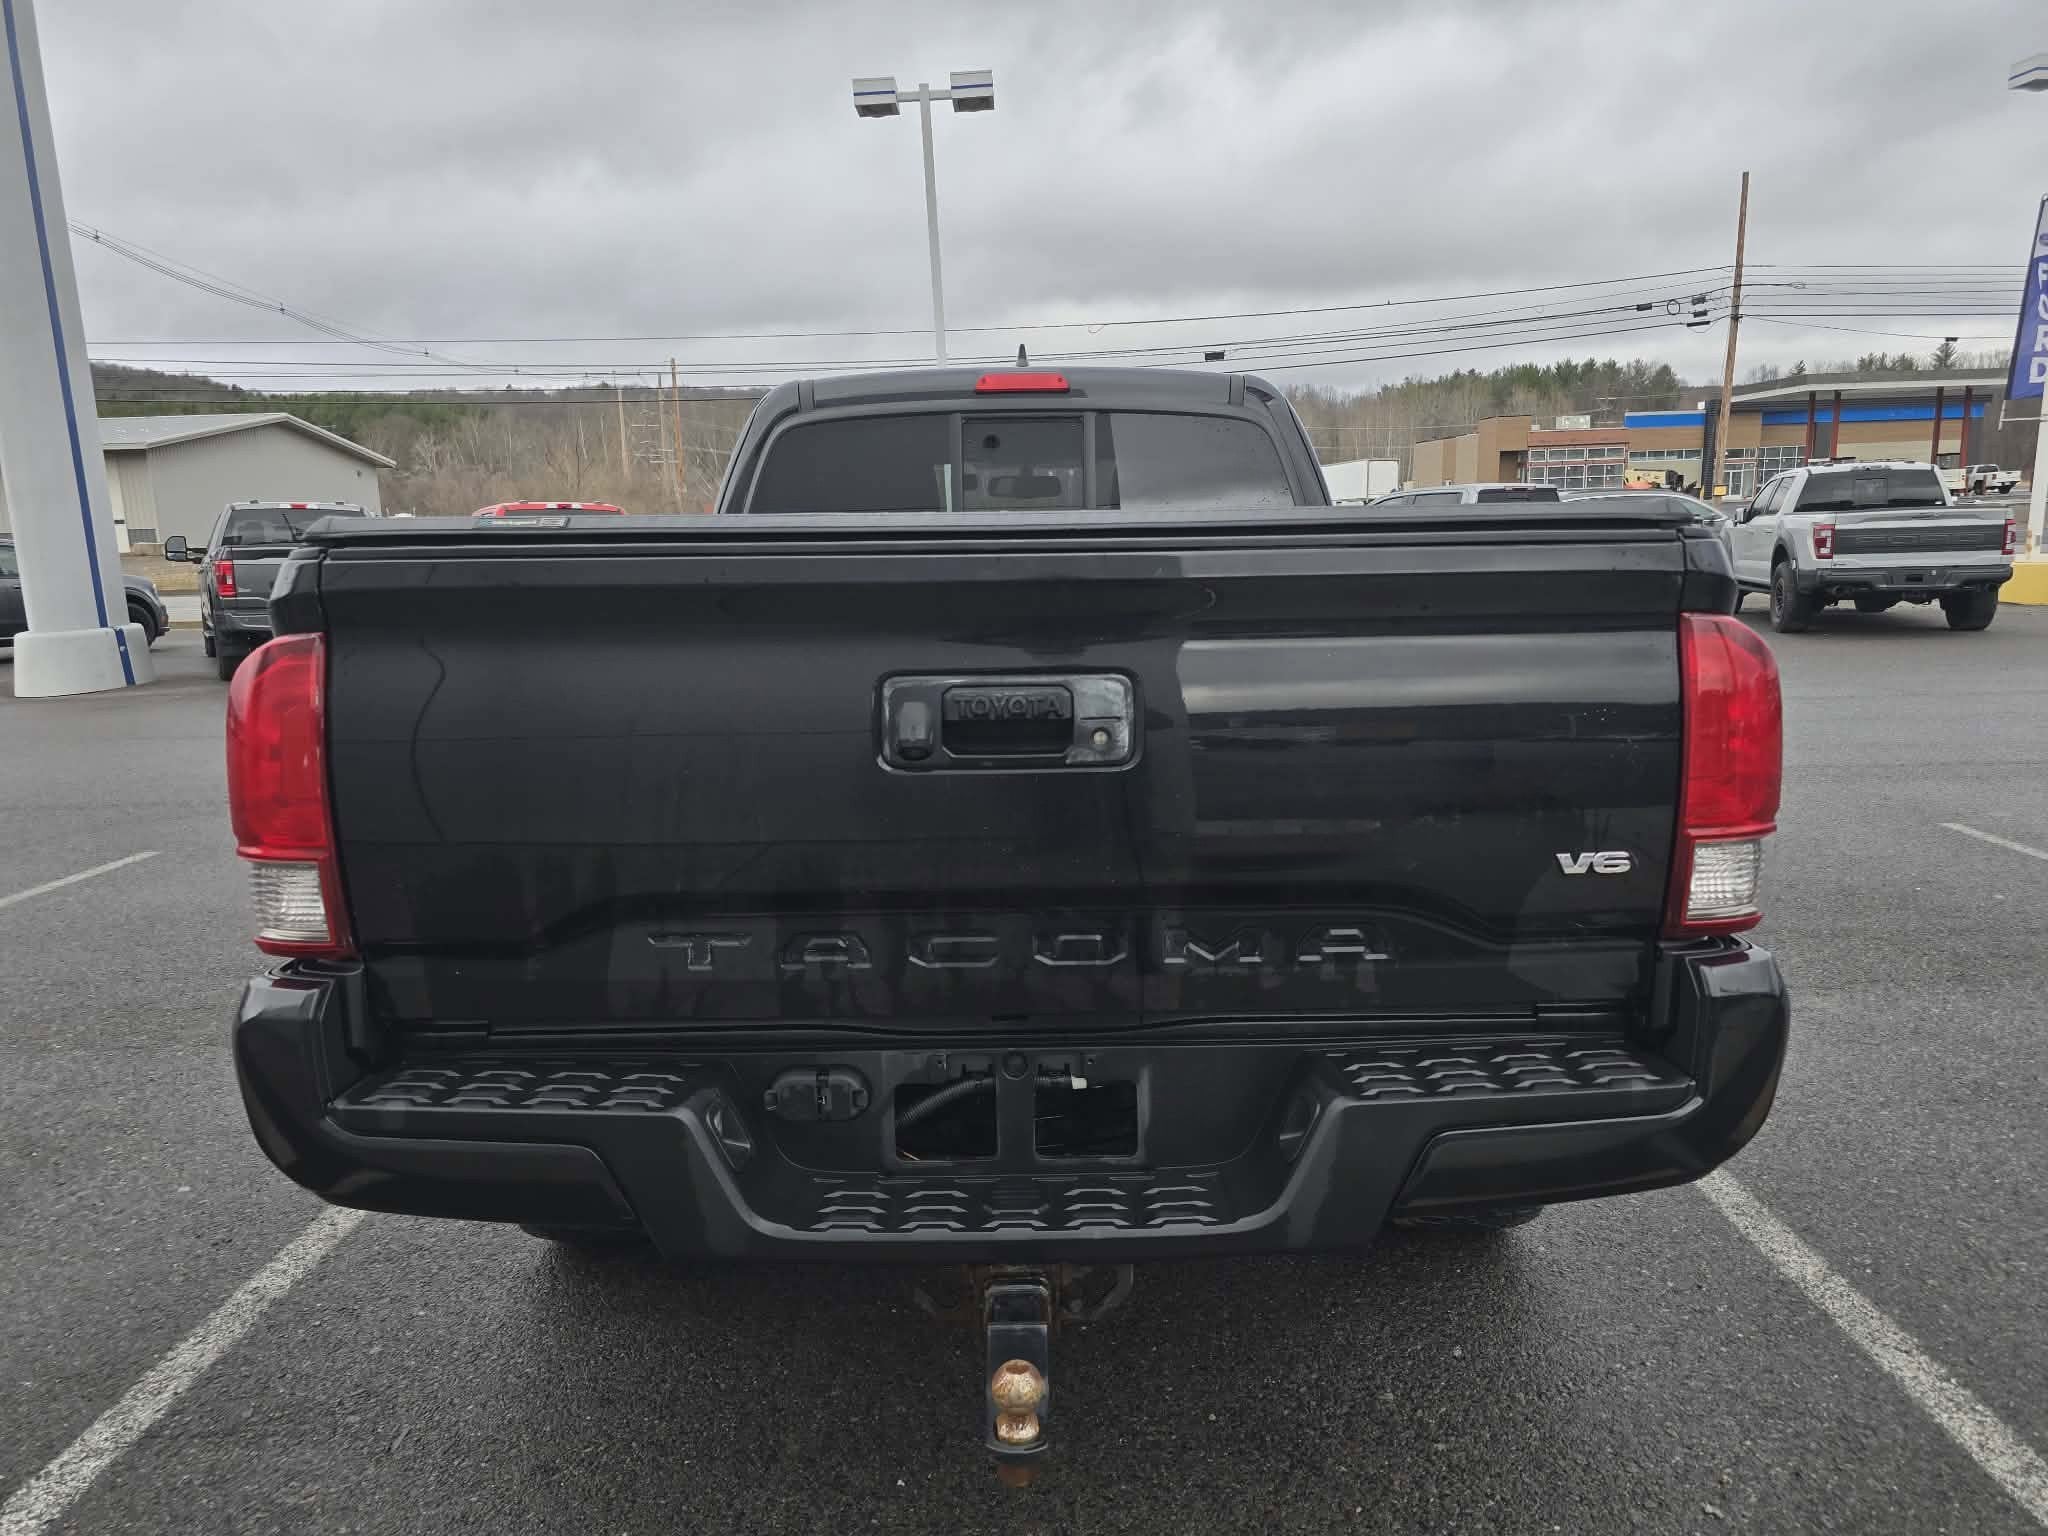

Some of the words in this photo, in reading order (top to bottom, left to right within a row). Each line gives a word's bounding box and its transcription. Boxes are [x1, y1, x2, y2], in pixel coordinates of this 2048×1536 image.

[953, 695, 1065, 720] TOYOTA
[1555, 850, 1632, 875] V6
[647, 923, 1392, 971] TACOMA
